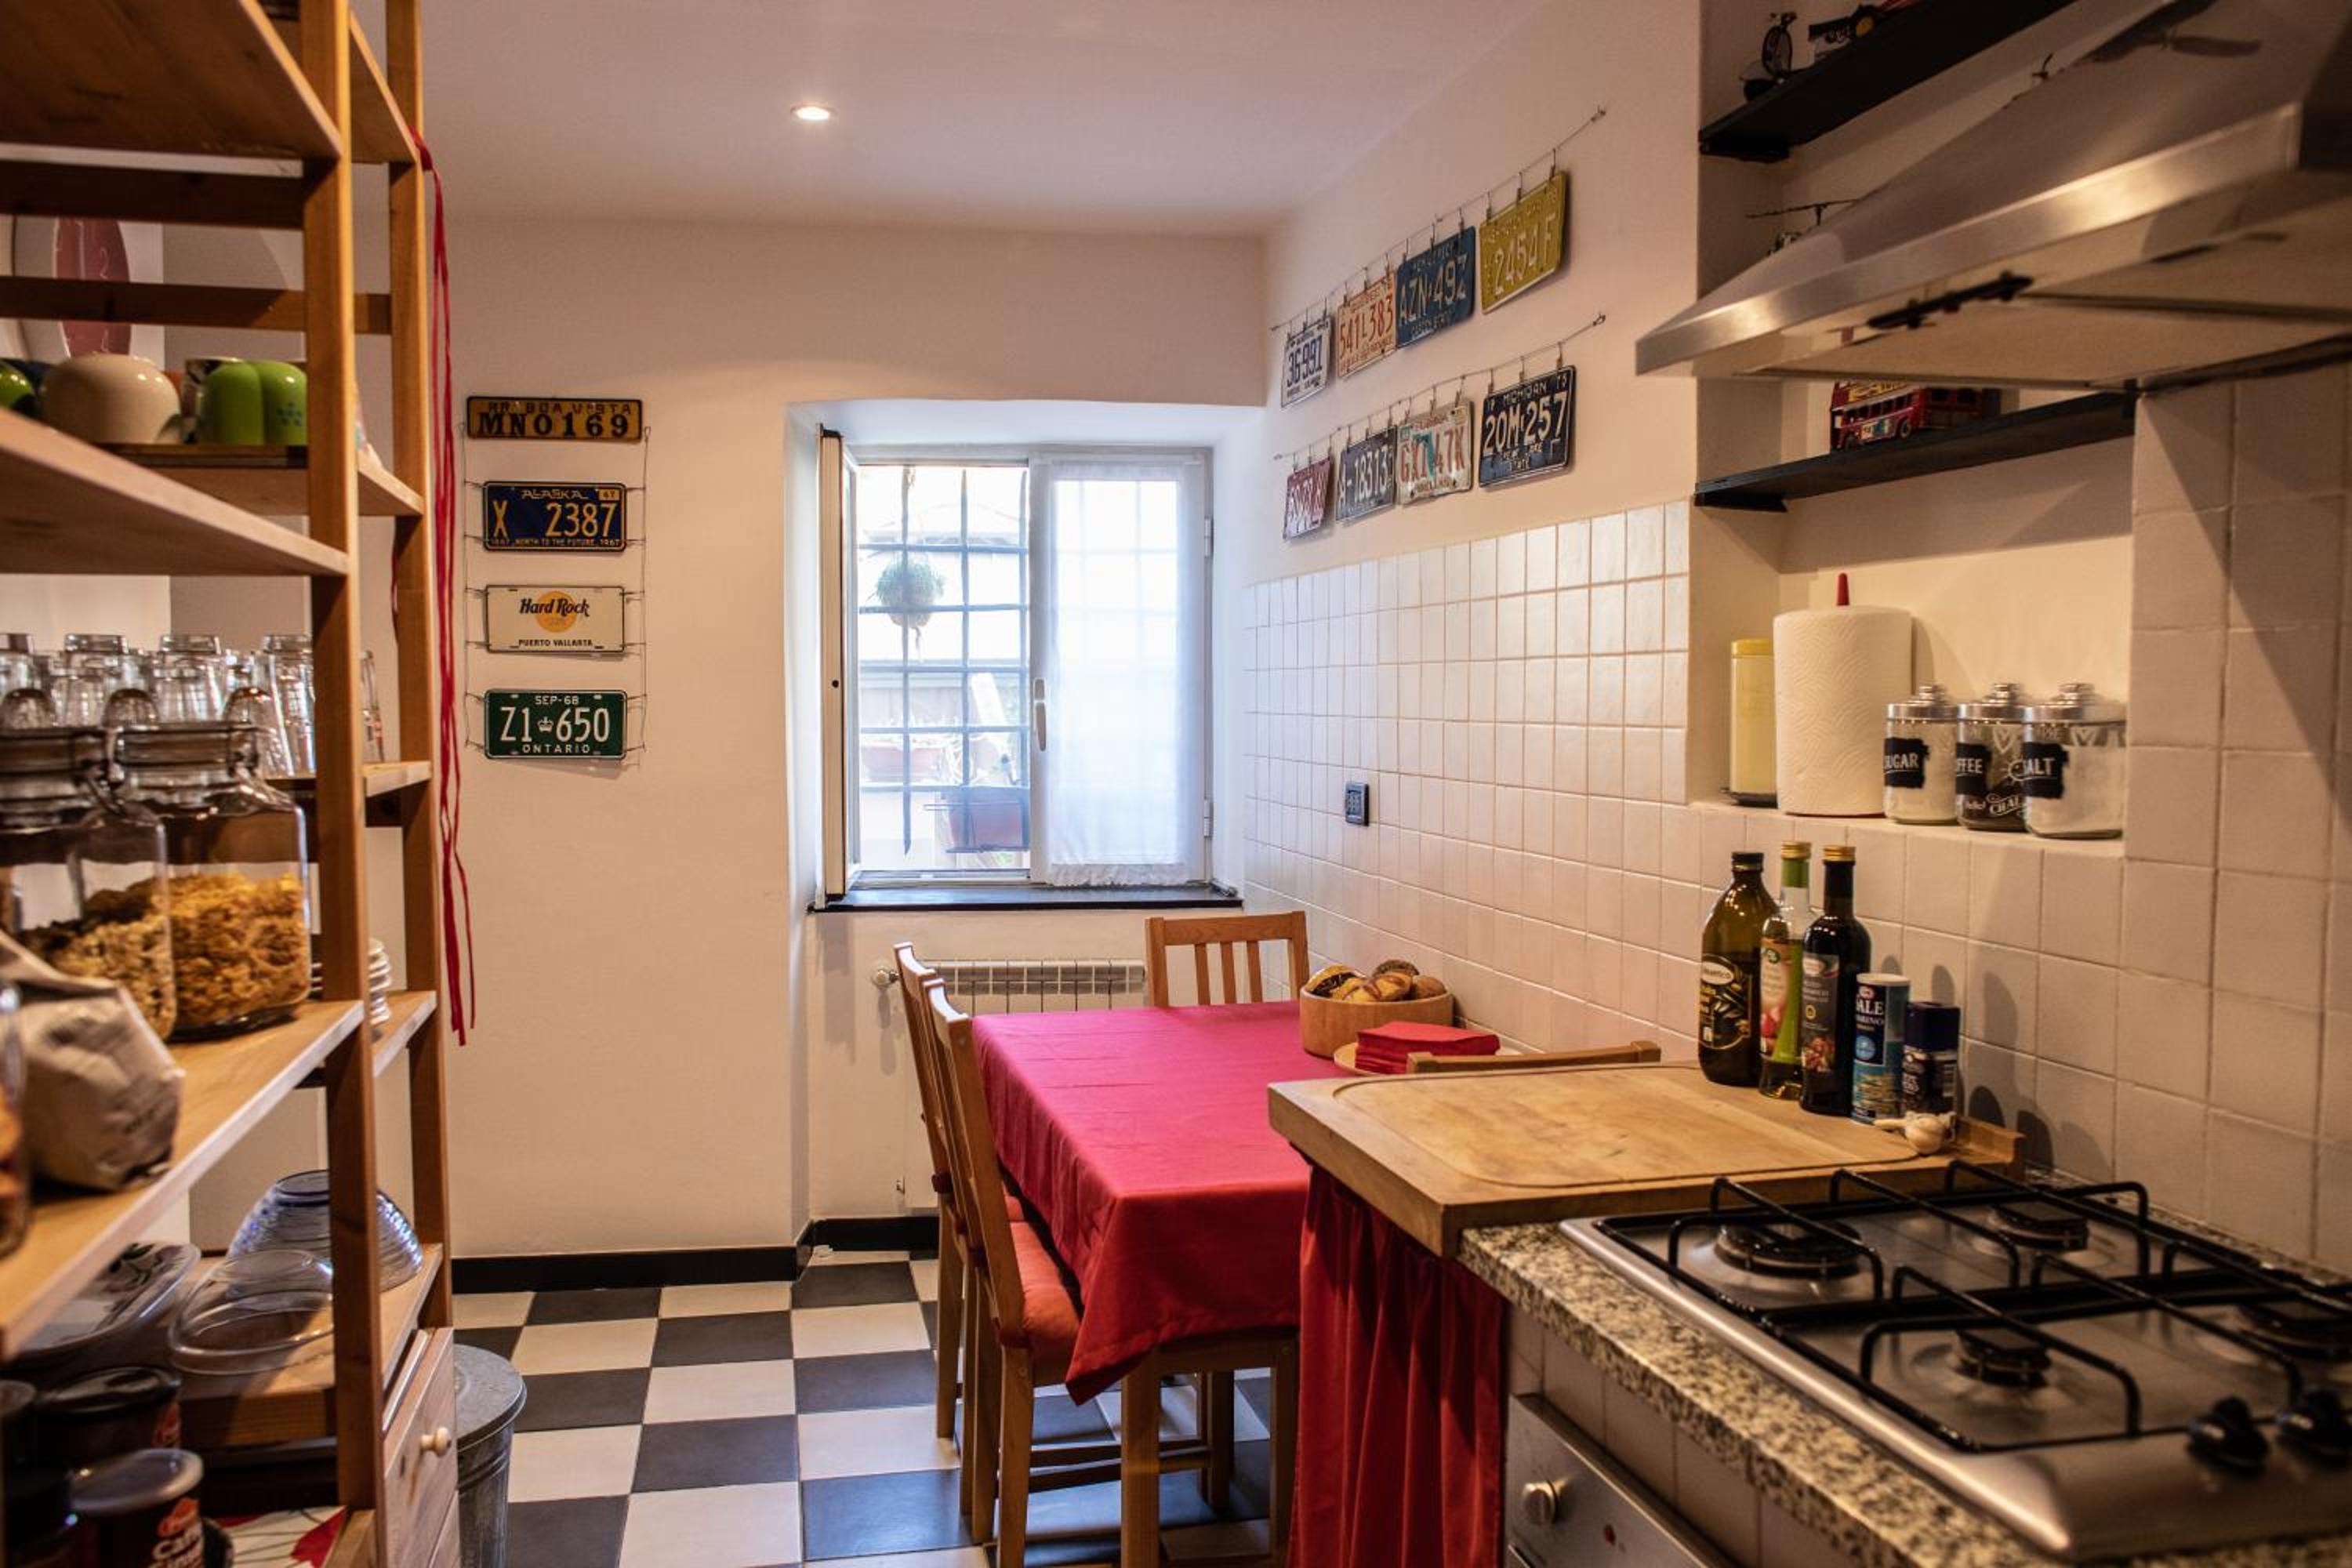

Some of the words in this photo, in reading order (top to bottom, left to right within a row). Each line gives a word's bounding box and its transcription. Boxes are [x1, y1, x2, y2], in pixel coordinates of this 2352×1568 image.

[521, 488, 589, 499] ALASKA
[492, 499, 508, 539] X
[545, 502, 618, 538] 2387
[519, 598, 555, 614] Hard
[556, 598, 590, 617] Rock
[535, 695, 579, 706] SEP-68
[499, 706, 532, 743] Z1
[556, 707, 611, 743] 650
[522, 744, 590, 754] ONTARIO
